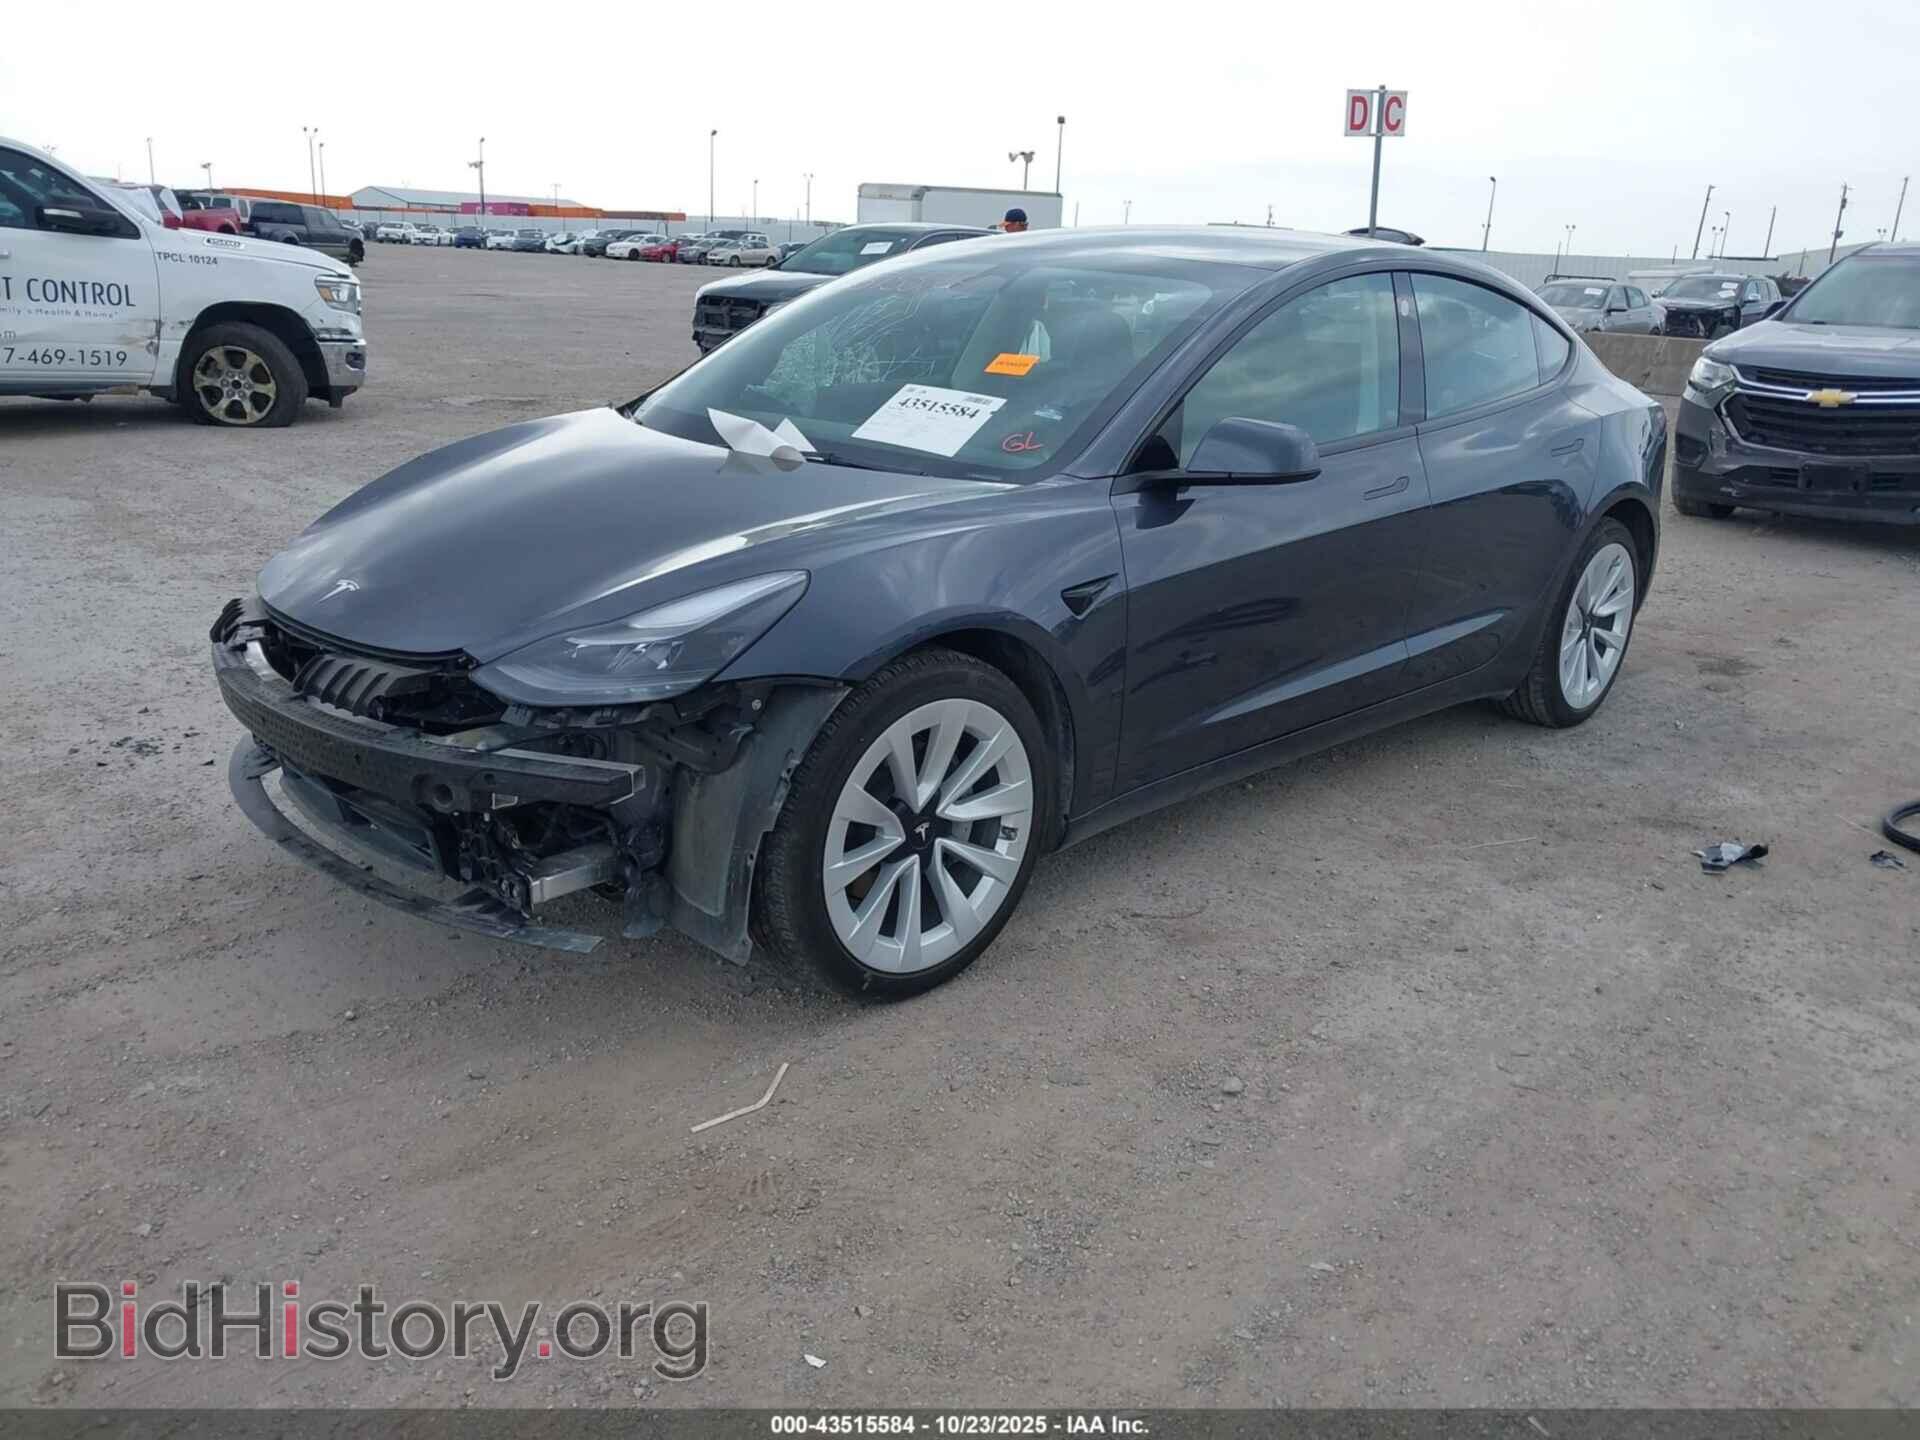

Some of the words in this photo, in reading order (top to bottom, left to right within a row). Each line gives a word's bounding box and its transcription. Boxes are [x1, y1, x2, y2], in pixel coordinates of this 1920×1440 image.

[1349, 95, 1369, 131] D
[1384, 95, 1403, 132] C
[156, 251, 185, 263] TPCL
[188, 254, 218, 265] 10124
[26, 277, 137, 308] CONTROL
[3, 346, 128, 368] 7-469-1519
[898, 396, 981, 420] 43515584
